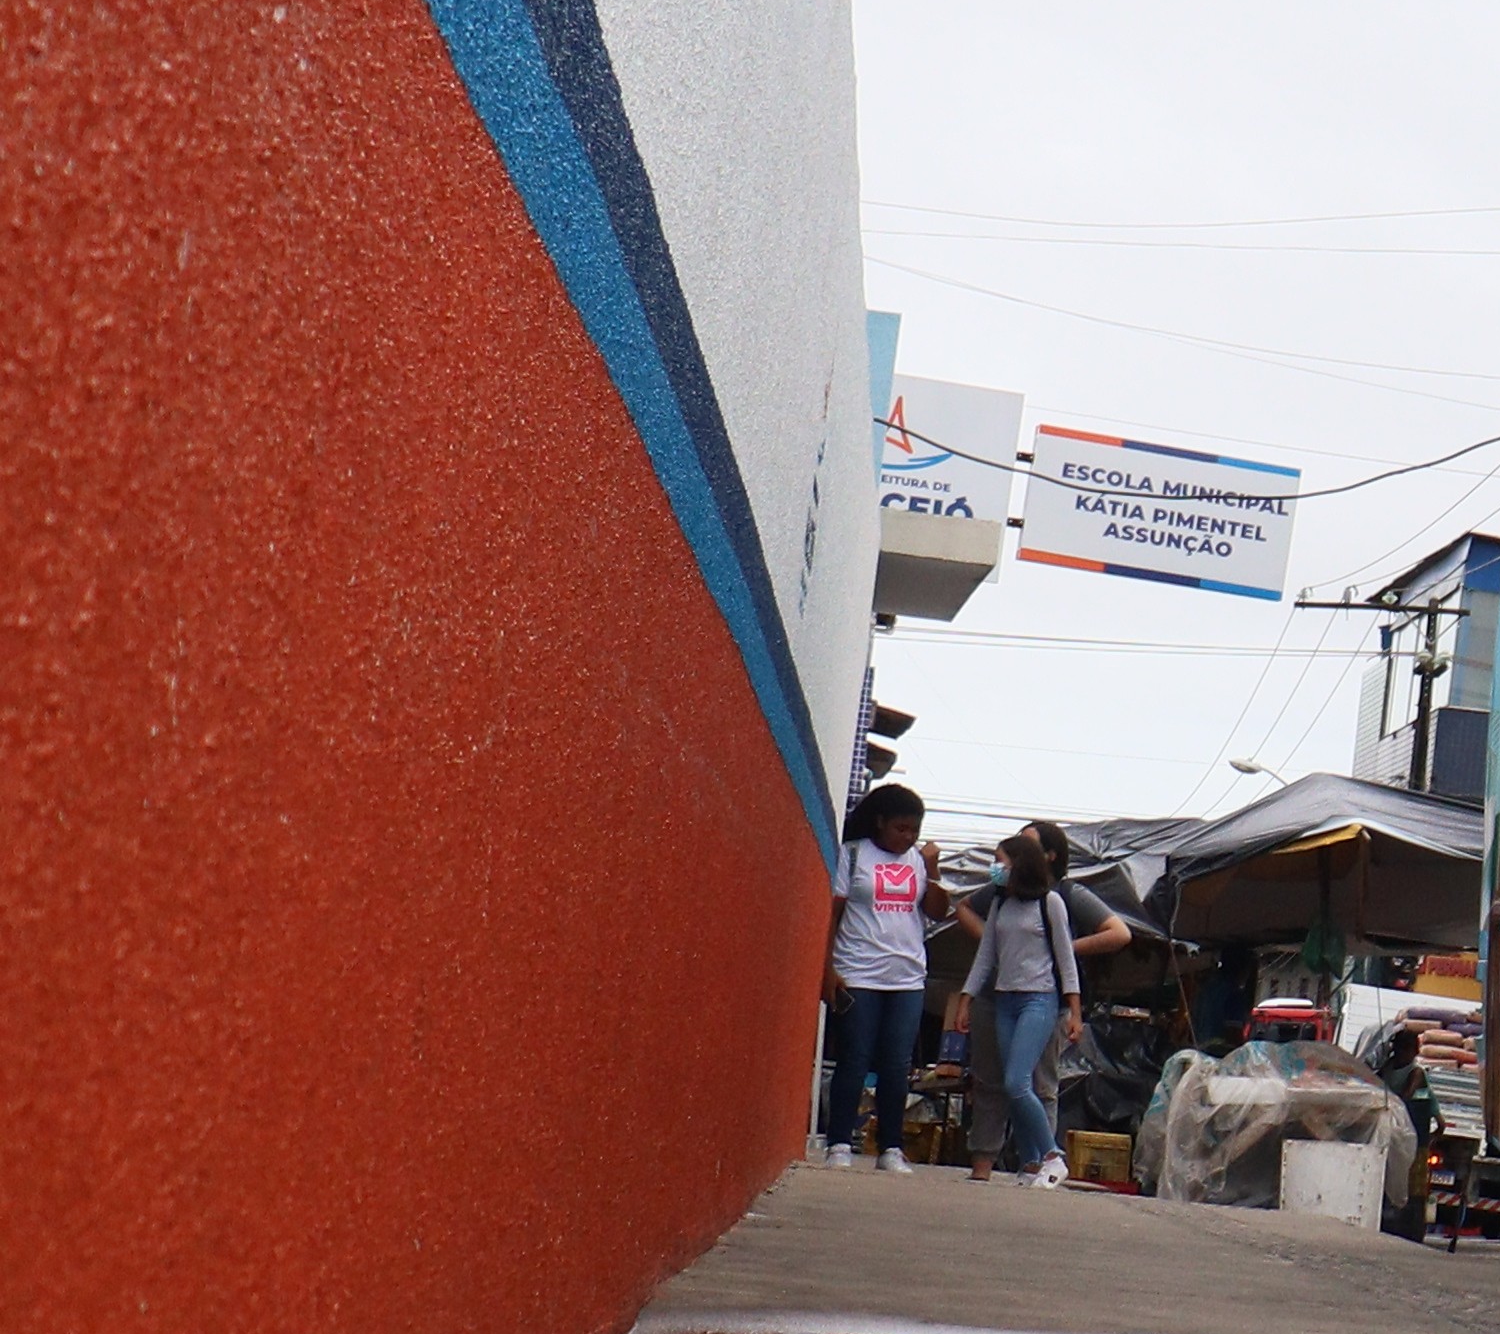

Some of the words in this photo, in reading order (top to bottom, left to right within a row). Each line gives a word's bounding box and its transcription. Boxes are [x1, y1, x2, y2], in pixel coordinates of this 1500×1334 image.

[881, 474, 929, 490] EITURA
[933, 482, 951, 492] DE
[1062, 462, 1153, 492] ESCOLA
[1162, 480, 1289, 516] MUNICIPAL
[880, 492, 973, 519] CEIÓ
[1075, 494, 1145, 521] KÁTIA
[1153, 508, 1267, 541] PIMENTEL
[1102, 522, 1232, 557] ASSUNÇÃO
[874, 903, 913, 913] VIRTUS
